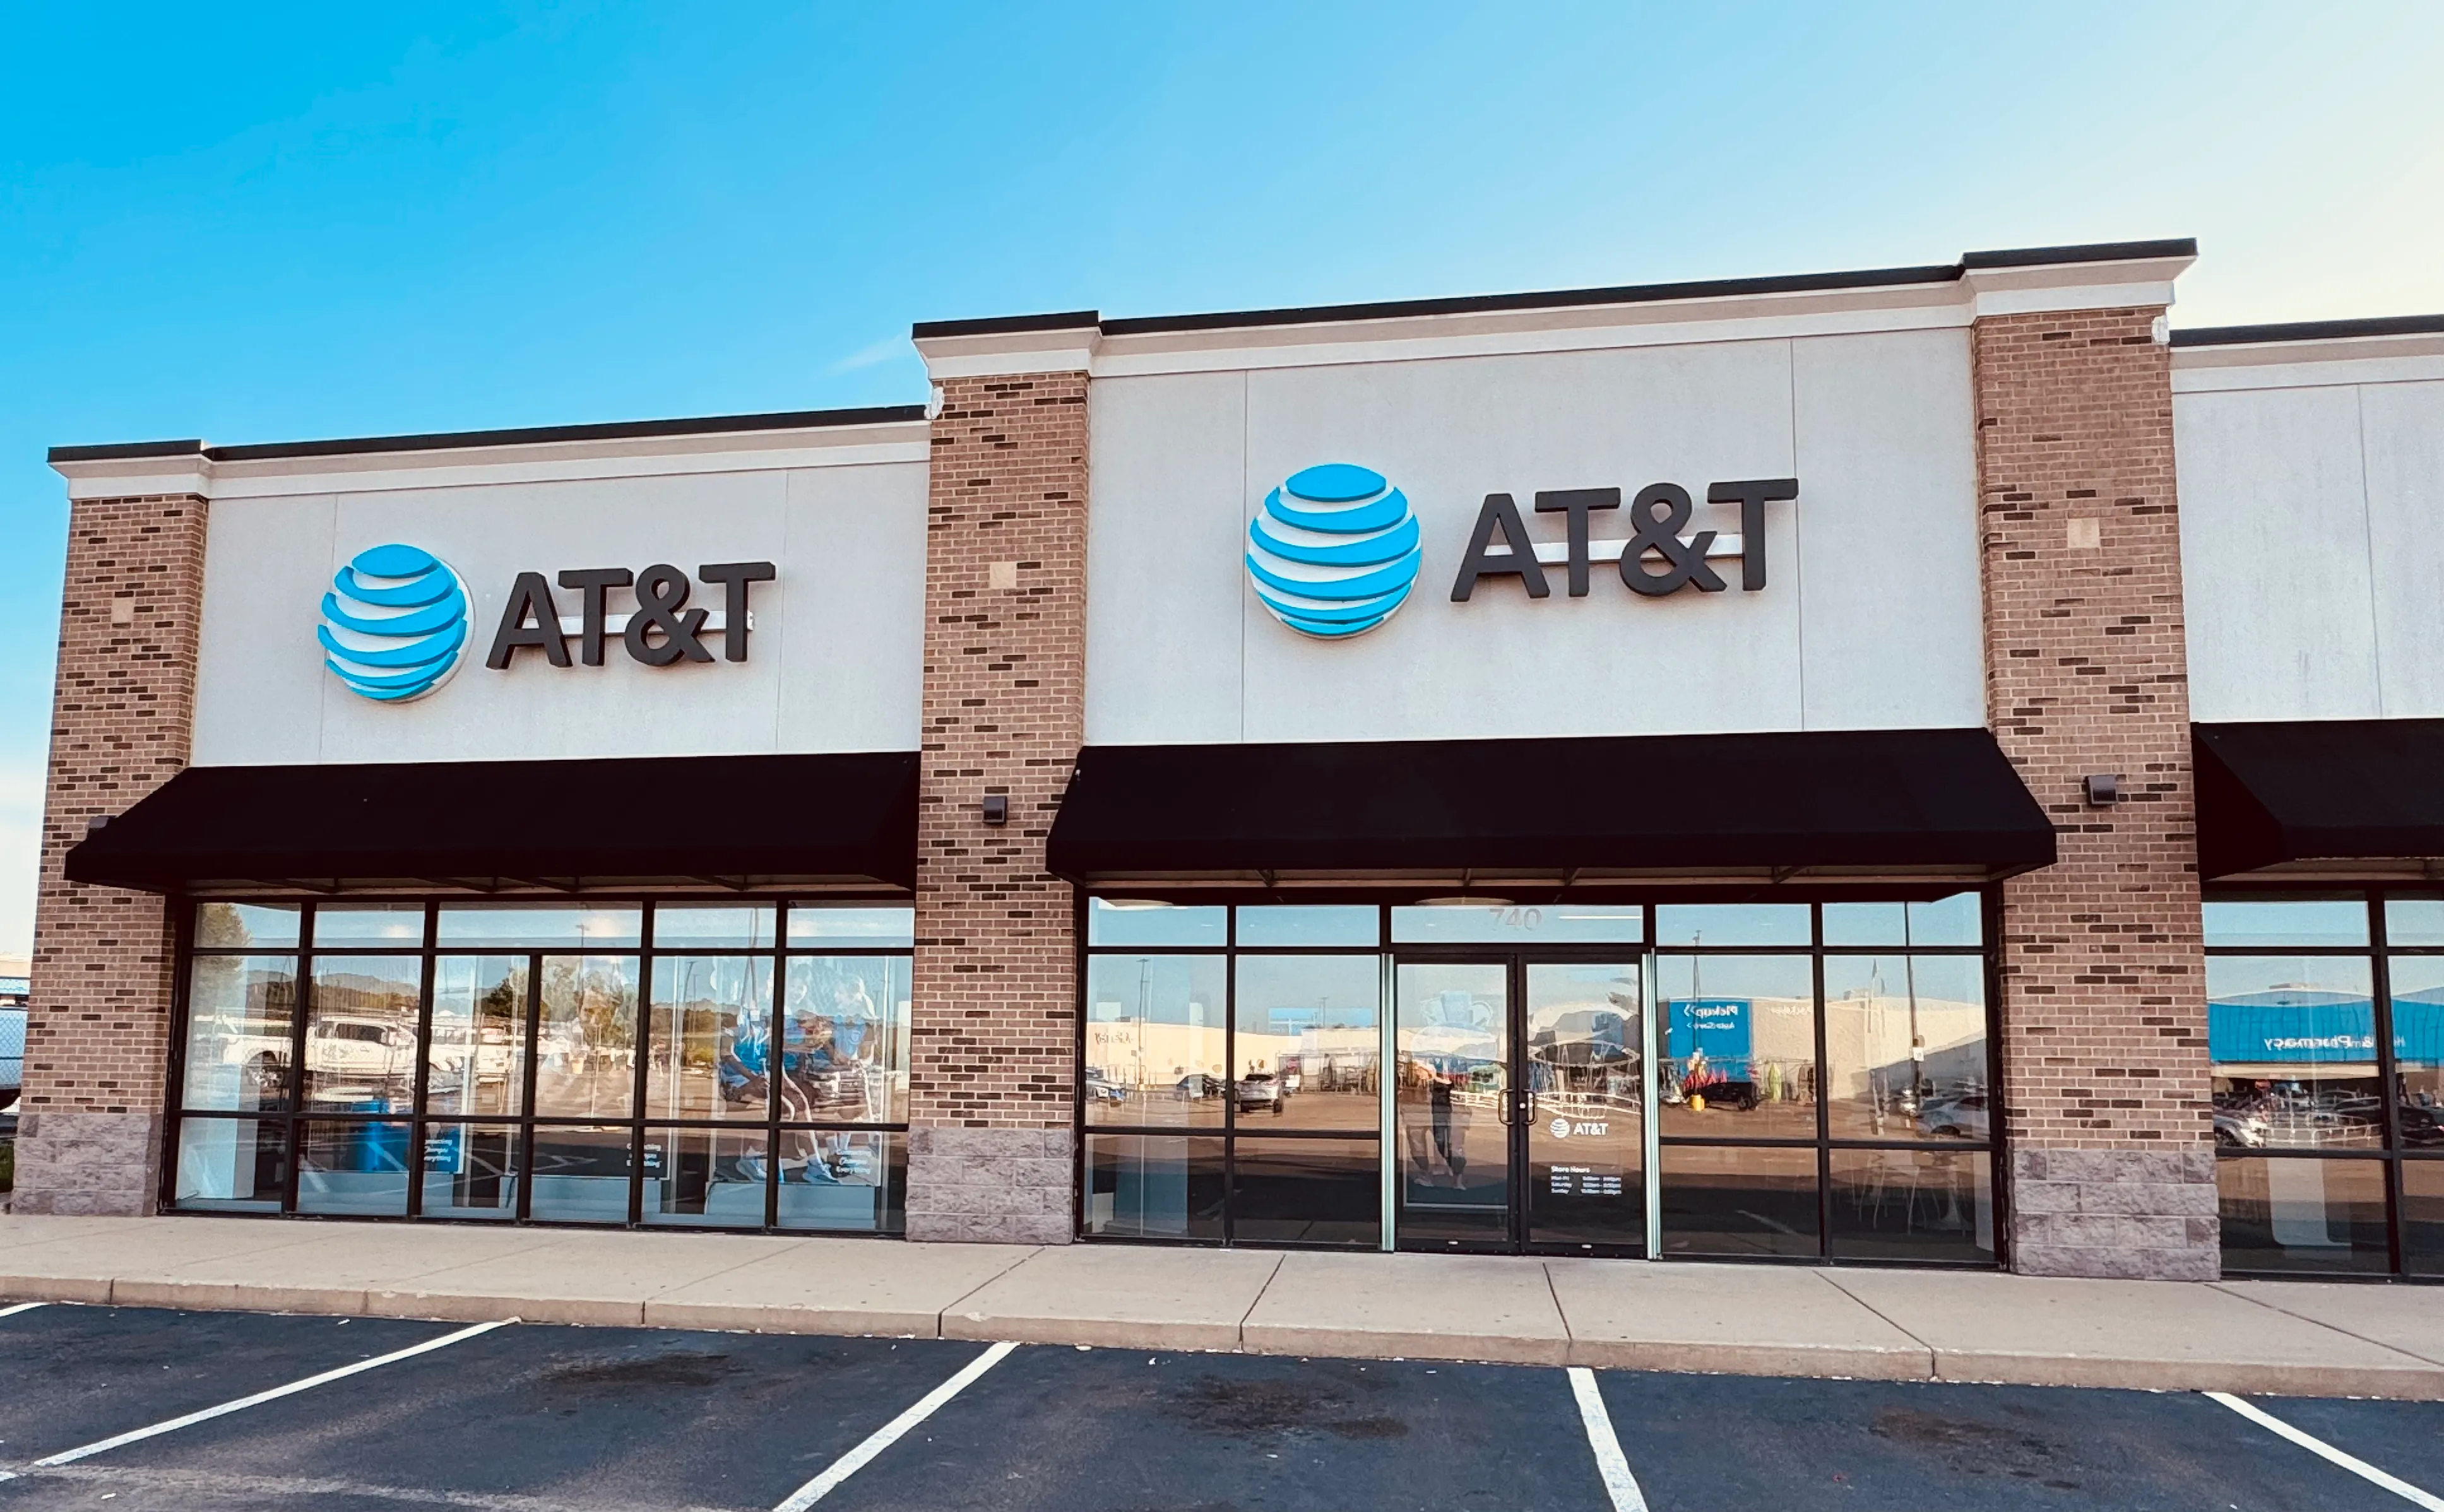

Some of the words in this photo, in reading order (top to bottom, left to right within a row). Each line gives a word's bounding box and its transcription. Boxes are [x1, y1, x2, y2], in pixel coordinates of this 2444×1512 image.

[1450, 478, 1799, 602] AT&T
[486, 561, 776, 670] AT&T
[1490, 907, 1543, 931] 740
[1573, 1123, 1608, 1135] AT&T
